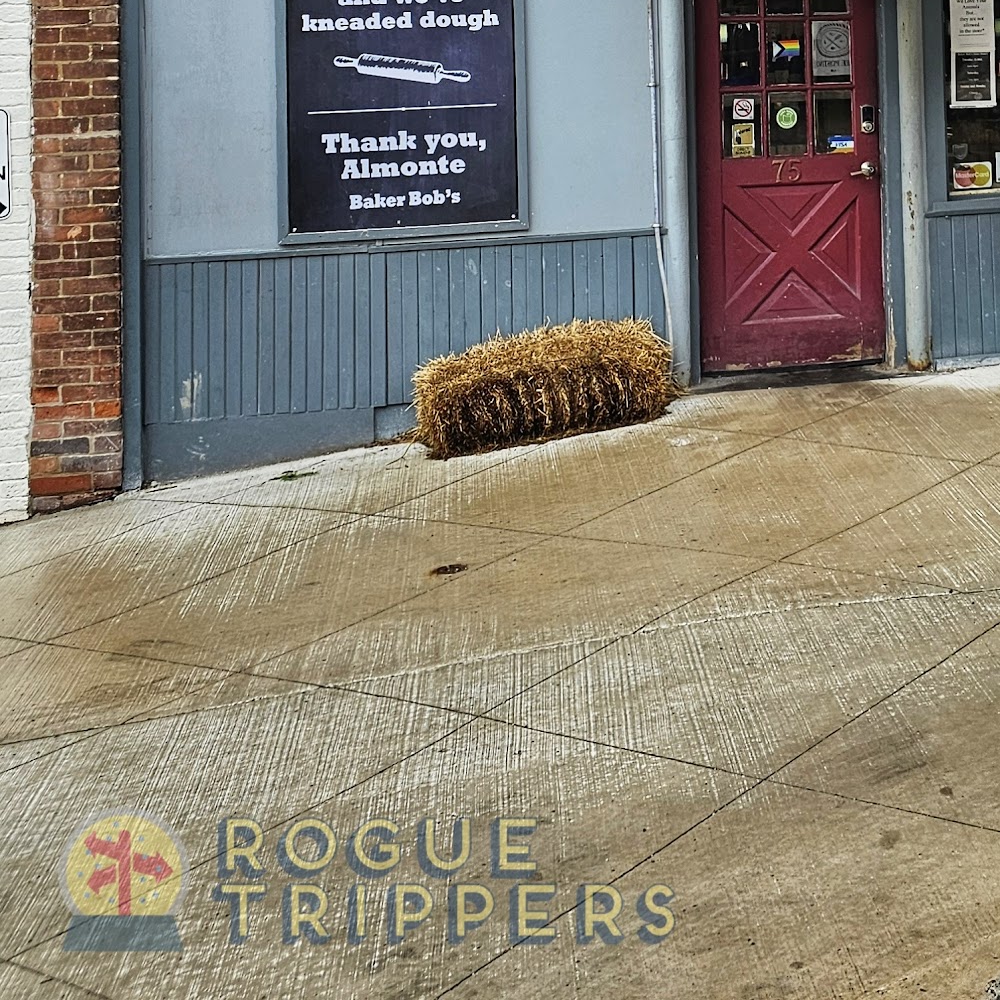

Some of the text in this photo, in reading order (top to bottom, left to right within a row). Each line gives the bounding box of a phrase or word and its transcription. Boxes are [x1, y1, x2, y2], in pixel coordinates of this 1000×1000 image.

[301, 9, 499, 32] kneaded dough
[321, 131, 487, 154] Thank you,
[341, 155, 466, 179] Almonte
[771, 159, 801, 183] 75
[349, 189, 461, 210] Baker Bob's
